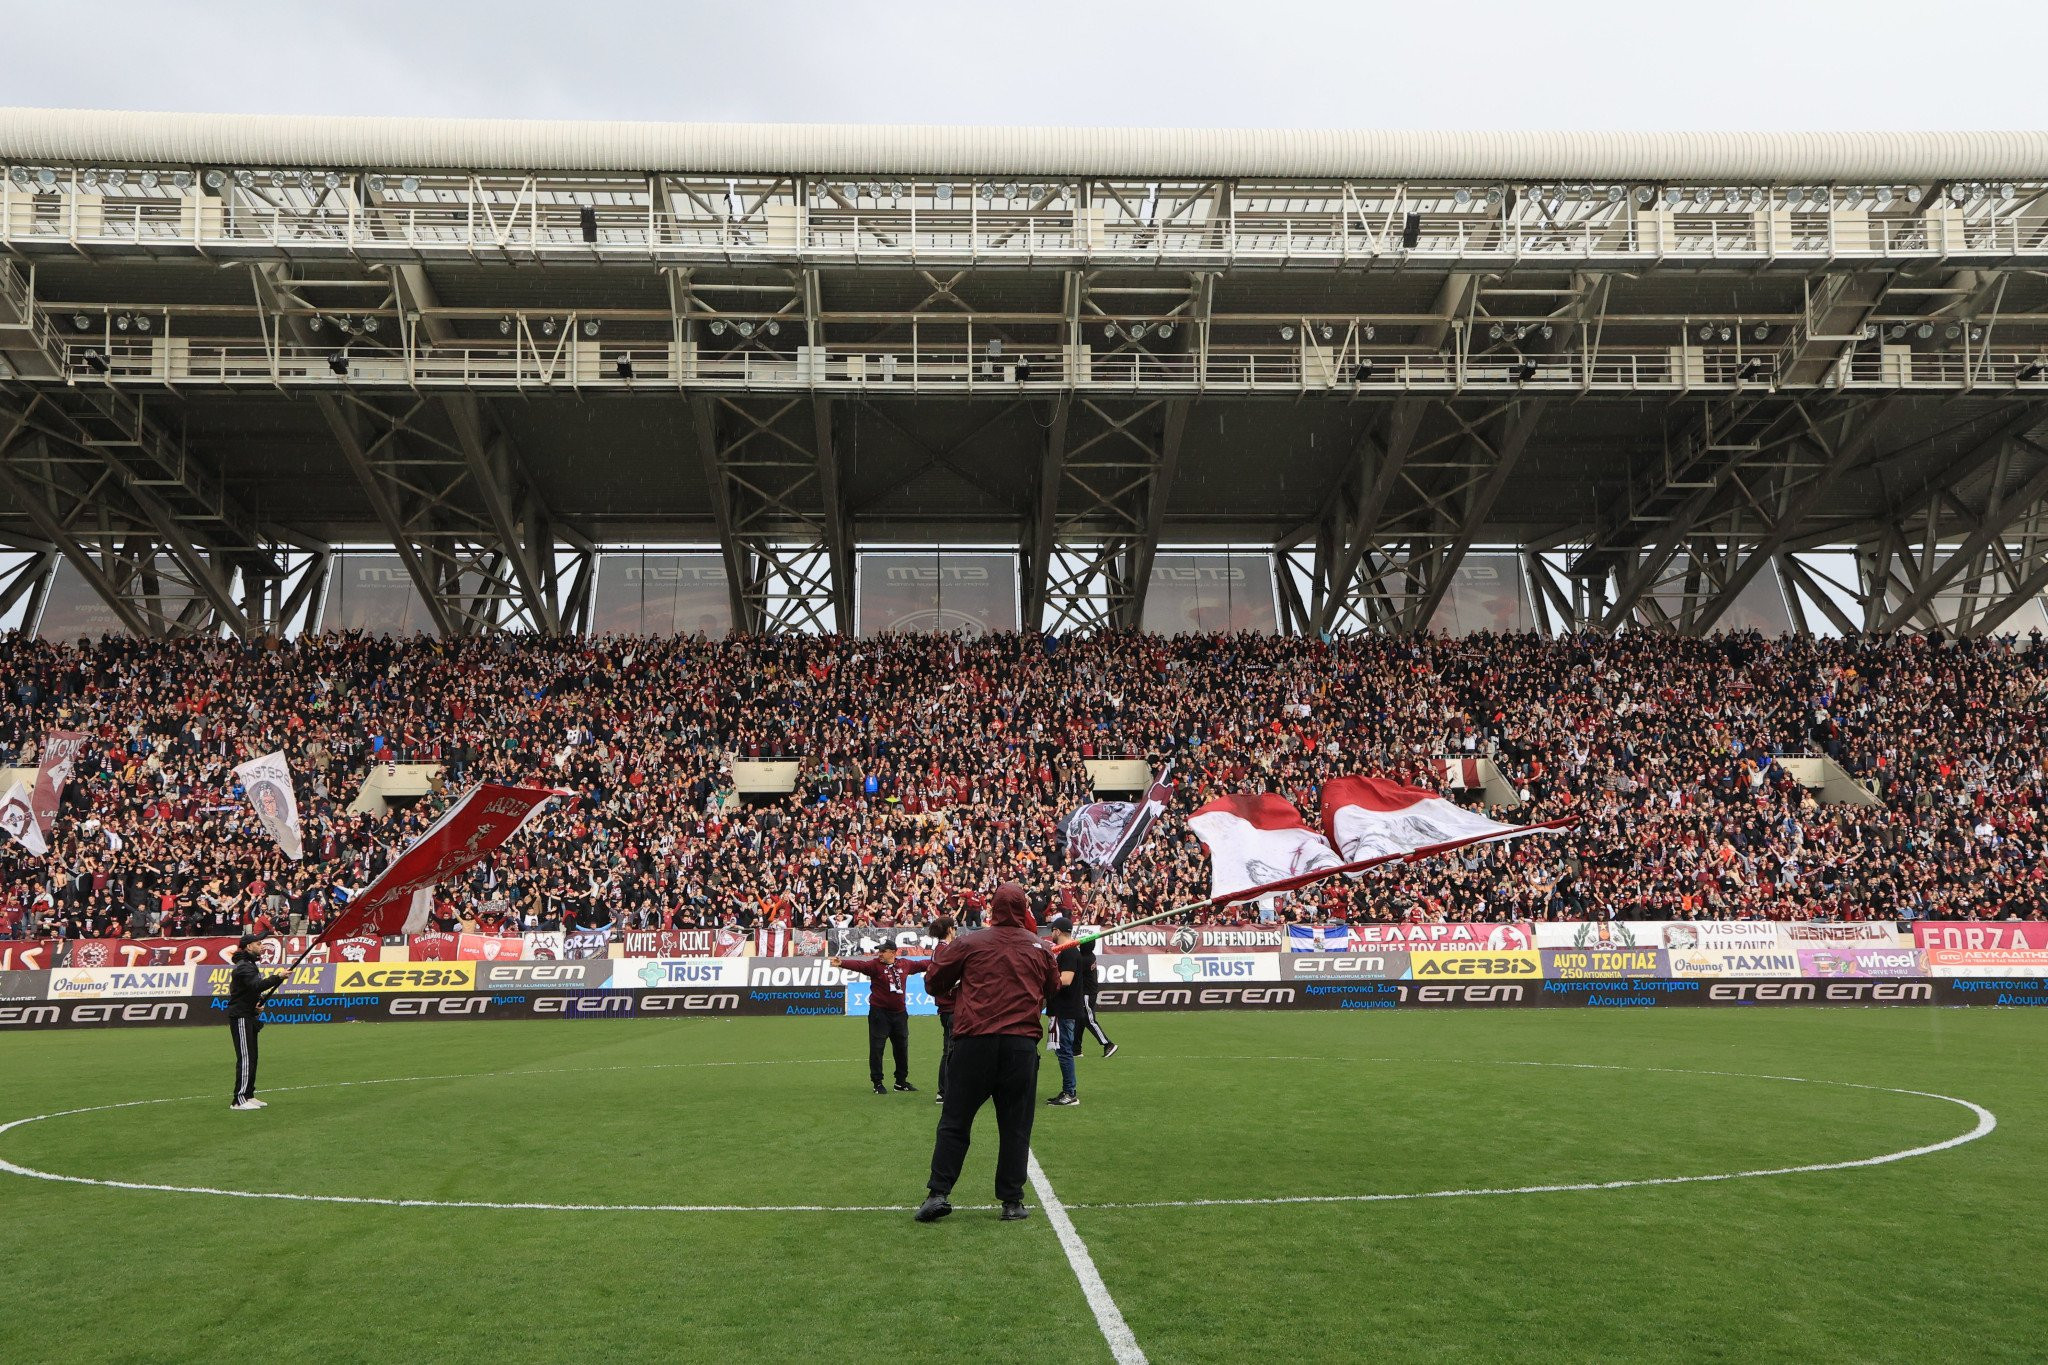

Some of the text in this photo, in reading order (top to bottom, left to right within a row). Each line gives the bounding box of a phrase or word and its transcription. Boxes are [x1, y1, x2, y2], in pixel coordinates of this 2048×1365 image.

[1701, 924, 1772, 935] VISSINI
[626, 930, 711, 952] KATE RINI
[1104, 931, 1166, 946] CRIMSON
[1202, 931, 1282, 946] DEFENDERS
[1922, 928, 2030, 950] FORZA
[1409, 943, 1436, 952] ΤΟΥ
[1195, 956, 1255, 977] TRUST
[1293, 957, 1385, 972] ETEM
[1553, 952, 1657, 970] AUTO ΤΣΟΓΙΑΣ
[1723, 955, 1795, 970] TAXINI
[1856, 951, 1915, 968] wheel
[489, 966, 585, 981] ETEM
[661, 961, 723, 982] TRUST
[1560, 968, 1583, 979] 250
[111, 972, 189, 989] TAXINI
[1543, 979, 1699, 994] Αρχιτεκτονικά Συστήματα
[1952, 978, 2039, 992] Αρχιτεκτονικά
[750, 991, 821, 1001] Αρχιτεκτονικά
[1096, 988, 1295, 1005] ETEM ETEM
[1305, 982, 1374, 996] Αρχιτεκτονικά
[1418, 985, 1524, 1002] ETEM
[1709, 983, 1933, 1000] ETEM ETEM
[308, 993, 379, 1010] Συστήματα
[533, 994, 739, 1012] ETEM ETEM
[1340, 999, 1396, 1010] Αλουμινίου
[1588, 994, 1656, 1007] Αλουμινίου
[70, 1003, 188, 1022] ETEM
[258, 1010, 332, 1024] Αλουμινίου
[786, 1004, 843, 1016] Αλουμινίου
